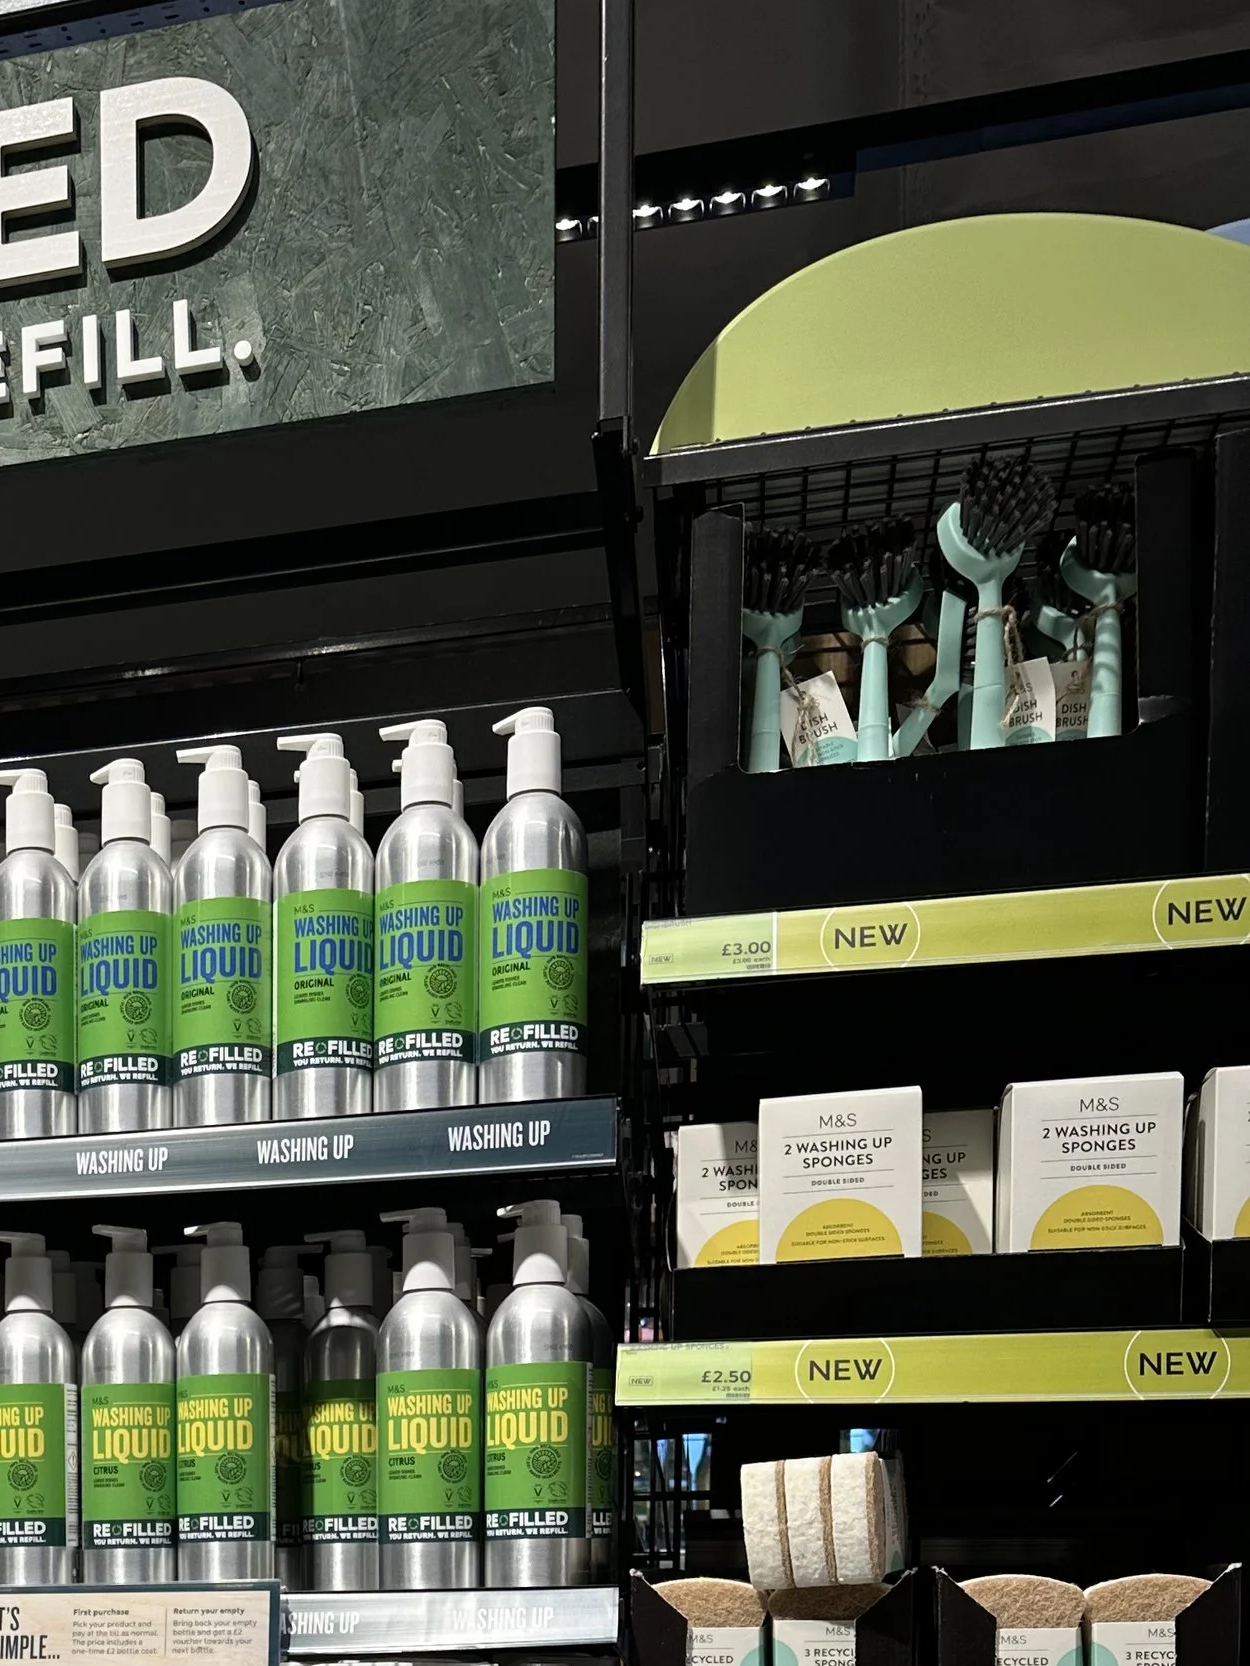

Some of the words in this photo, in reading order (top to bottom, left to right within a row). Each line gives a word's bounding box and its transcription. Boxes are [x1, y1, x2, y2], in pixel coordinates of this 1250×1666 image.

[1062, 703, 1087, 714] DISH
[1010, 713, 1043, 727] BRUSH
[492, 888, 511, 899] M&S
[492, 897, 559, 922] WASHING
[564, 896, 579, 917] UP
[1168, 896, 1247, 925] NEW
[492, 920, 579, 959] LIQUID
[834, 922, 907, 949] NEW
[722, 941, 771, 956] £3.00
[492, 961, 531, 976] ORIGINAL
[491, 1043, 506, 1054] YOU
[509, 1041, 540, 1052] RETURN.
[542, 1040, 552, 1048] WE
[1080, 1097, 1119, 1112] M&S
[820, 1114, 857, 1128] M&S
[448, 1123, 525, 1151] WASHING
[529, 1121, 550, 1146] UP
[785, 1145, 792, 1155] 2
[797, 1139, 867, 1153] WASHING
[873, 1137, 892, 1149] UP
[803, 1154, 873, 1168] SPONGES
[1139, 1351, 1216, 1376] NEW
[701, 1370, 751, 1384] £2.50
[388, 1394, 452, 1416] WASHING
[457, 1395, 472, 1413] UP
[388, 1417, 472, 1456] LIQUID
[388, 1456, 415, 1467] CITRUS
[73, 1608, 90, 1616] First
[93, 1609, 129, 1617] purchase
[173, 1607, 199, 1615] Return
[201, 1608, 218, 1616] your
[220, 1607, 244, 1615] empty
